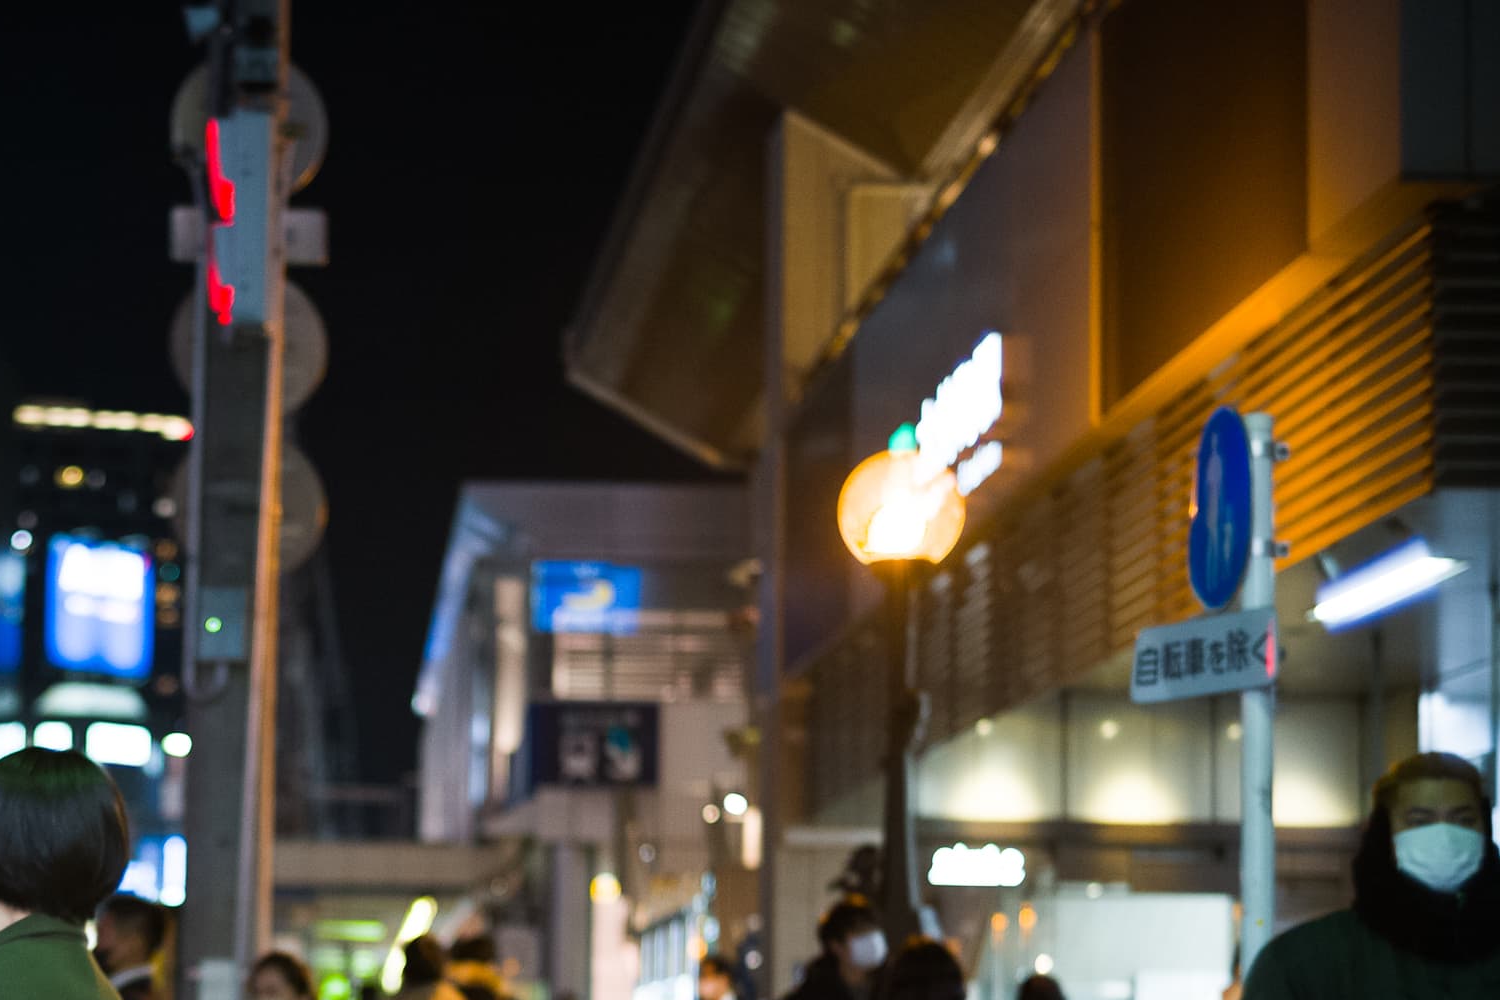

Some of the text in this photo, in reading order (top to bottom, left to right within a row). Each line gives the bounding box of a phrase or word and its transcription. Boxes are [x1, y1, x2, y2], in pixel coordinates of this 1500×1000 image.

[1135, 628, 1270, 686] 自転車を除く
